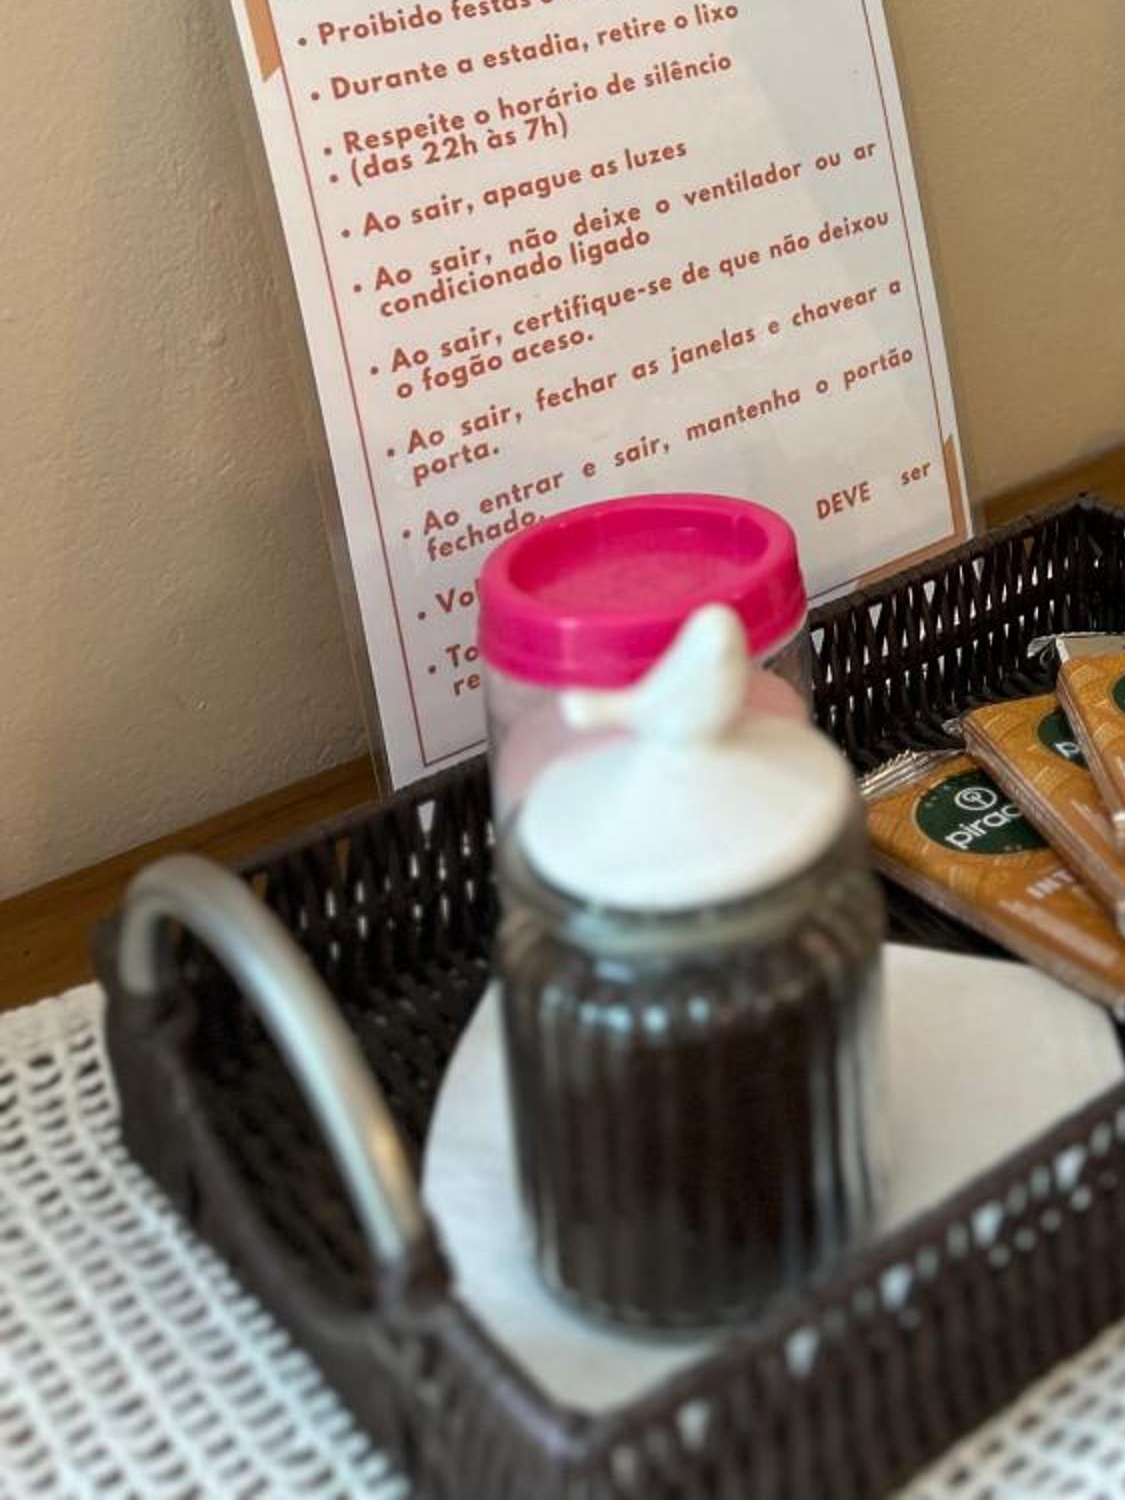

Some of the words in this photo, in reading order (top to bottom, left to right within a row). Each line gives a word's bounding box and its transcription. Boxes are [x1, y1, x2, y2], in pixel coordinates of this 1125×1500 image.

[316, 3, 444, 47] Proibido
[329, 61, 449, 101] Durante
[455, 57, 475, 75] a
[482, 32, 590, 69] estadia,
[596, 16, 667, 47] retire
[673, 14, 689, 30] o
[693, 3, 739, 27] lixo
[342, 112, 466, 156] Respeite
[473, 108, 491, 126] o
[496, 81, 599, 121] horário
[605, 71, 637, 97] de
[643, 51, 733, 88] silêncio
[350, 152, 414, 188] (das
[420, 131, 479, 165] 22h
[486, 127, 518, 151] às
[522, 110, 569, 142] 7h)
[362, 211, 402, 238] Ao
[410, 193, 475, 226] sair,
[482, 168, 583, 209] apague
[589, 159, 619, 180] as
[623, 142, 688, 171] luzes
[374, 265, 413, 293] Ao
[428, 244, 493, 277] sair,
[507, 227, 559, 256] não
[572, 206, 641, 238] deixe
[655, 198, 671, 215] o
[681, 161, 803, 207] ventilador
[814, 152, 842, 172] ou
[852, 142, 877, 161] ar
[379, 249, 564, 319] condicionado
[568, 225, 651, 267] ligado
[390, 346, 430, 374] Ao
[439, 325, 503, 359] sair,
[512, 276, 673, 337] certifique-se
[681, 261, 711, 286] de
[718, 250, 761, 278] que
[768, 233, 811, 260] não
[817, 211, 889, 245] deixou
[395, 381, 414, 400] o
[421, 352, 504, 392] fogão
[511, 329, 595, 364] aceso.
[406, 427, 446, 455] Ao
[460, 403, 523, 437] sair,
[535, 371, 618, 413] fechar
[630, 359, 660, 381] as
[670, 327, 757, 375] janelas
[767, 320, 781, 335] e
[791, 286, 878, 328] chavear
[887, 279, 902, 296] a
[412, 441, 500, 489] porta.
[422, 509, 461, 537] Ao
[479, 471, 565, 515] entrar
[581, 461, 597, 479] e
[613, 435, 670, 468] sair,
[685, 387, 801, 442] mantenha
[815, 379, 829, 395] o
[842, 347, 914, 392] portão
[815, 480, 871, 521] DEVE
[900, 461, 931, 486] ser
